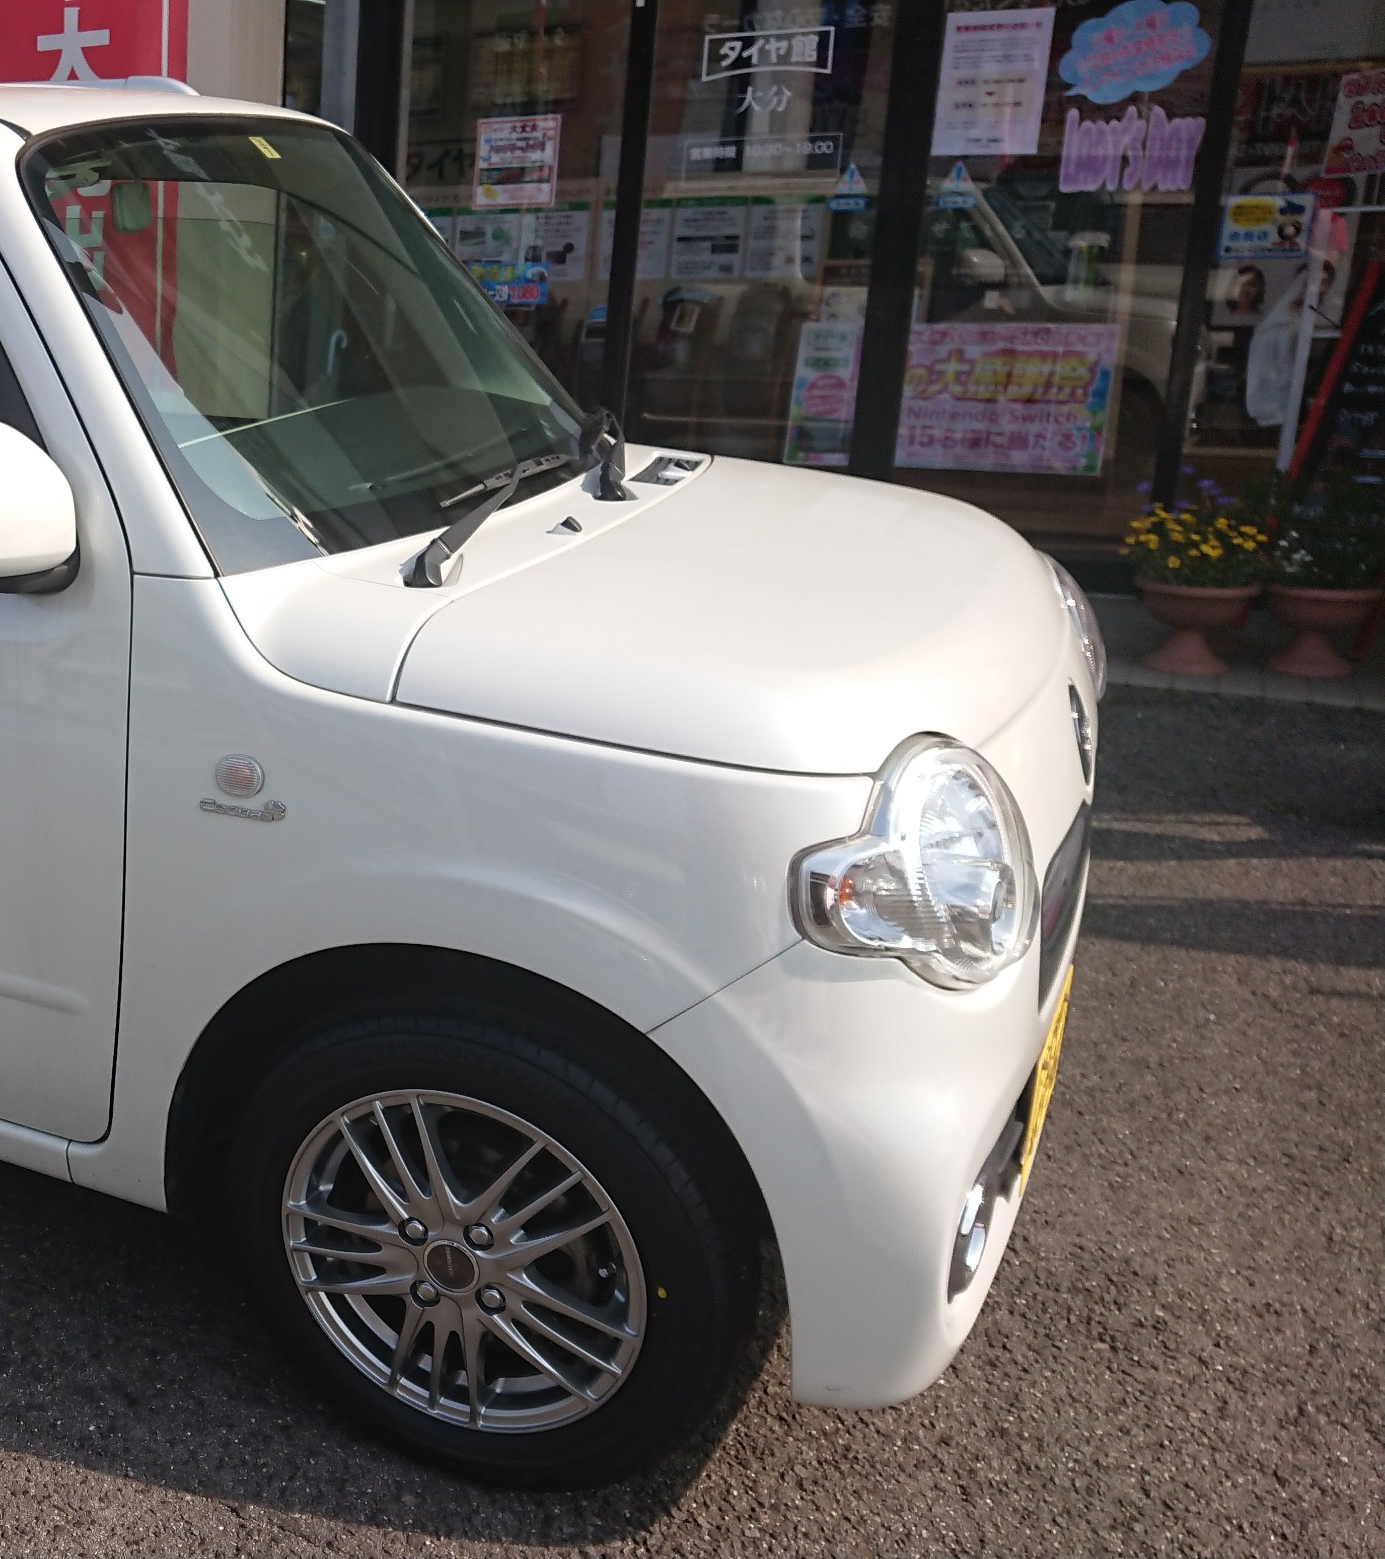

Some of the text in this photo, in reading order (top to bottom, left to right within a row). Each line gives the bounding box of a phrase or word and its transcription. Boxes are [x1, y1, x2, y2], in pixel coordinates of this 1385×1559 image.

[719, 34, 819, 67] タイヤ館
[735, 84, 793, 114] 大分
[905, 406, 1078, 425] Nintendo Switch
